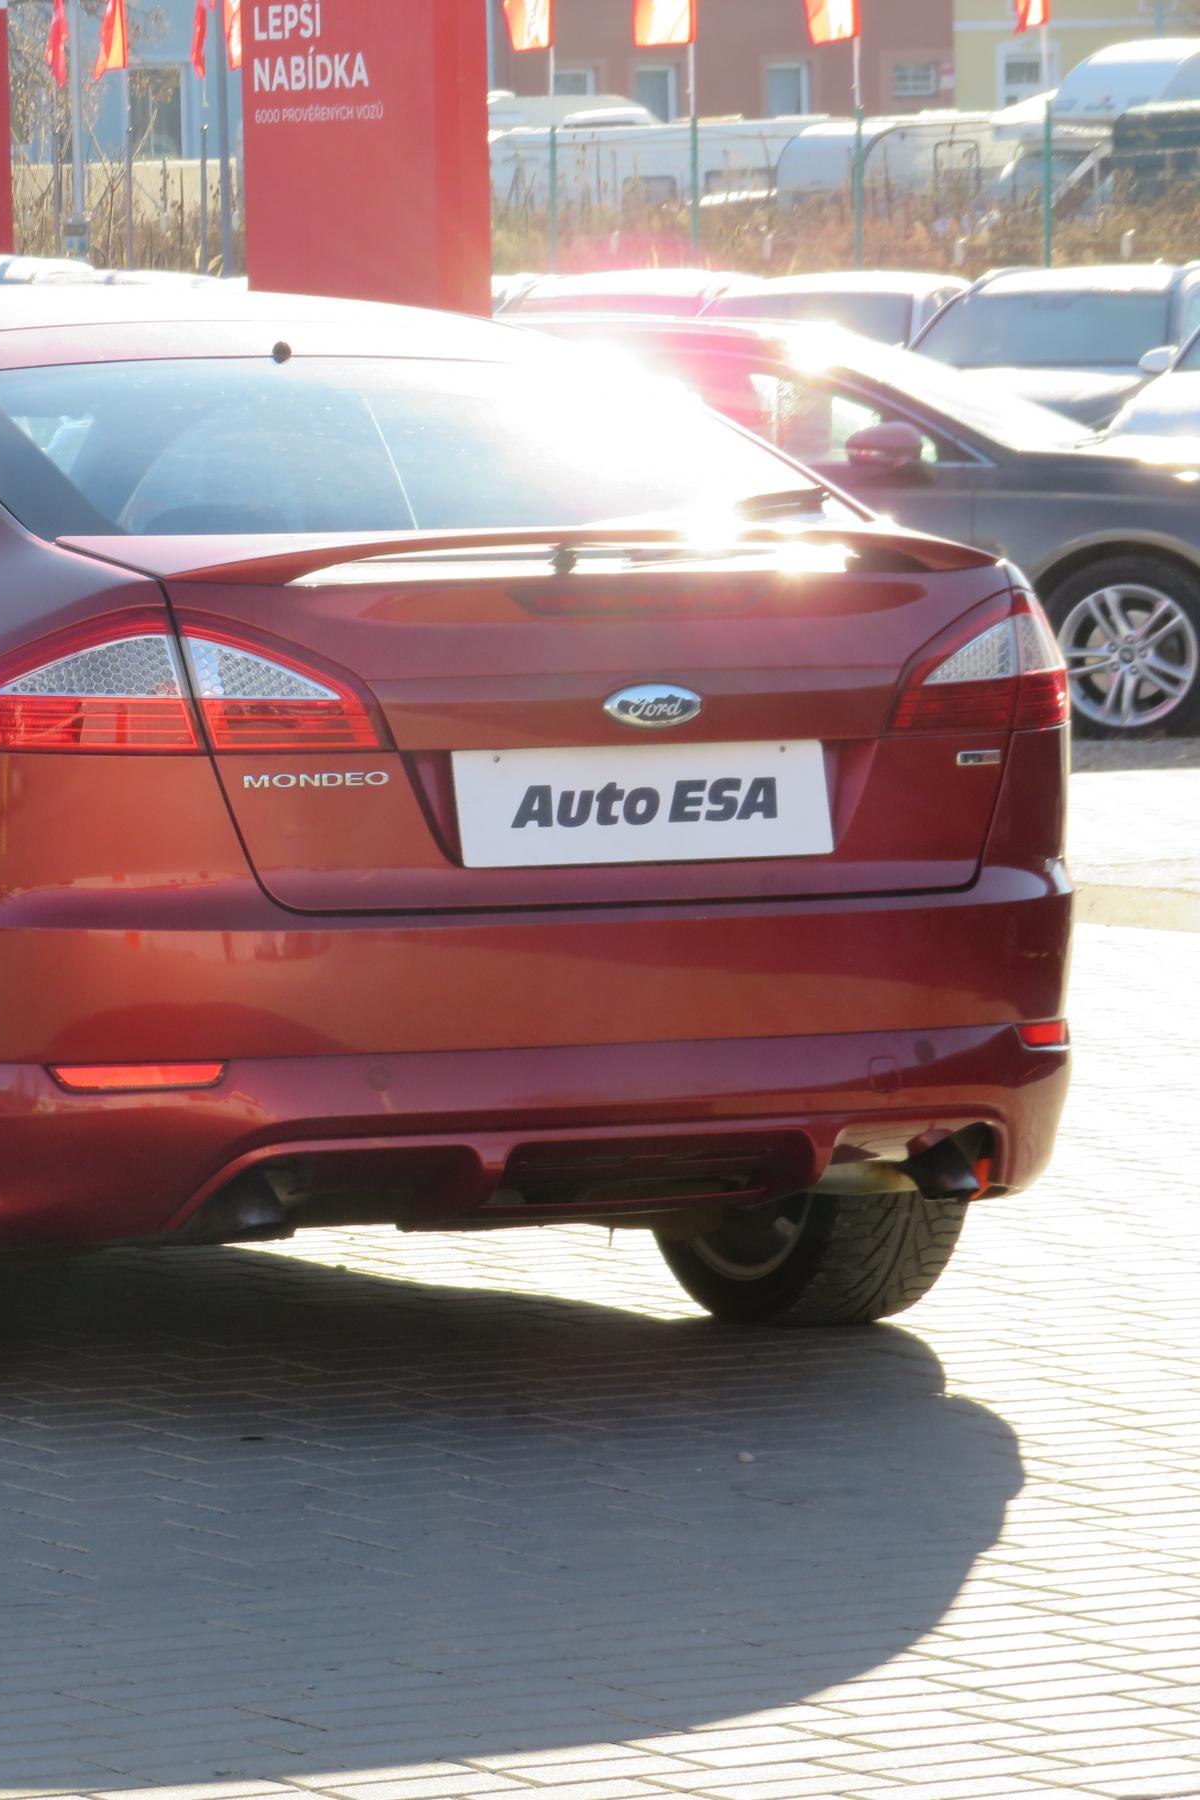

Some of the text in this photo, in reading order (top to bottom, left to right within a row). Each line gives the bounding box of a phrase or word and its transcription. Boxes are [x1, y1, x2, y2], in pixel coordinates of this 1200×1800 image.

[254, 0, 321, 41] LEPŠÍ
[253, 45, 369, 92] NABÍDKA
[255, 108, 280, 124] 6000
[629, 698, 682, 717] Ford
[243, 771, 390, 789] MONDEO
[510, 776, 779, 829] Auto ESA
